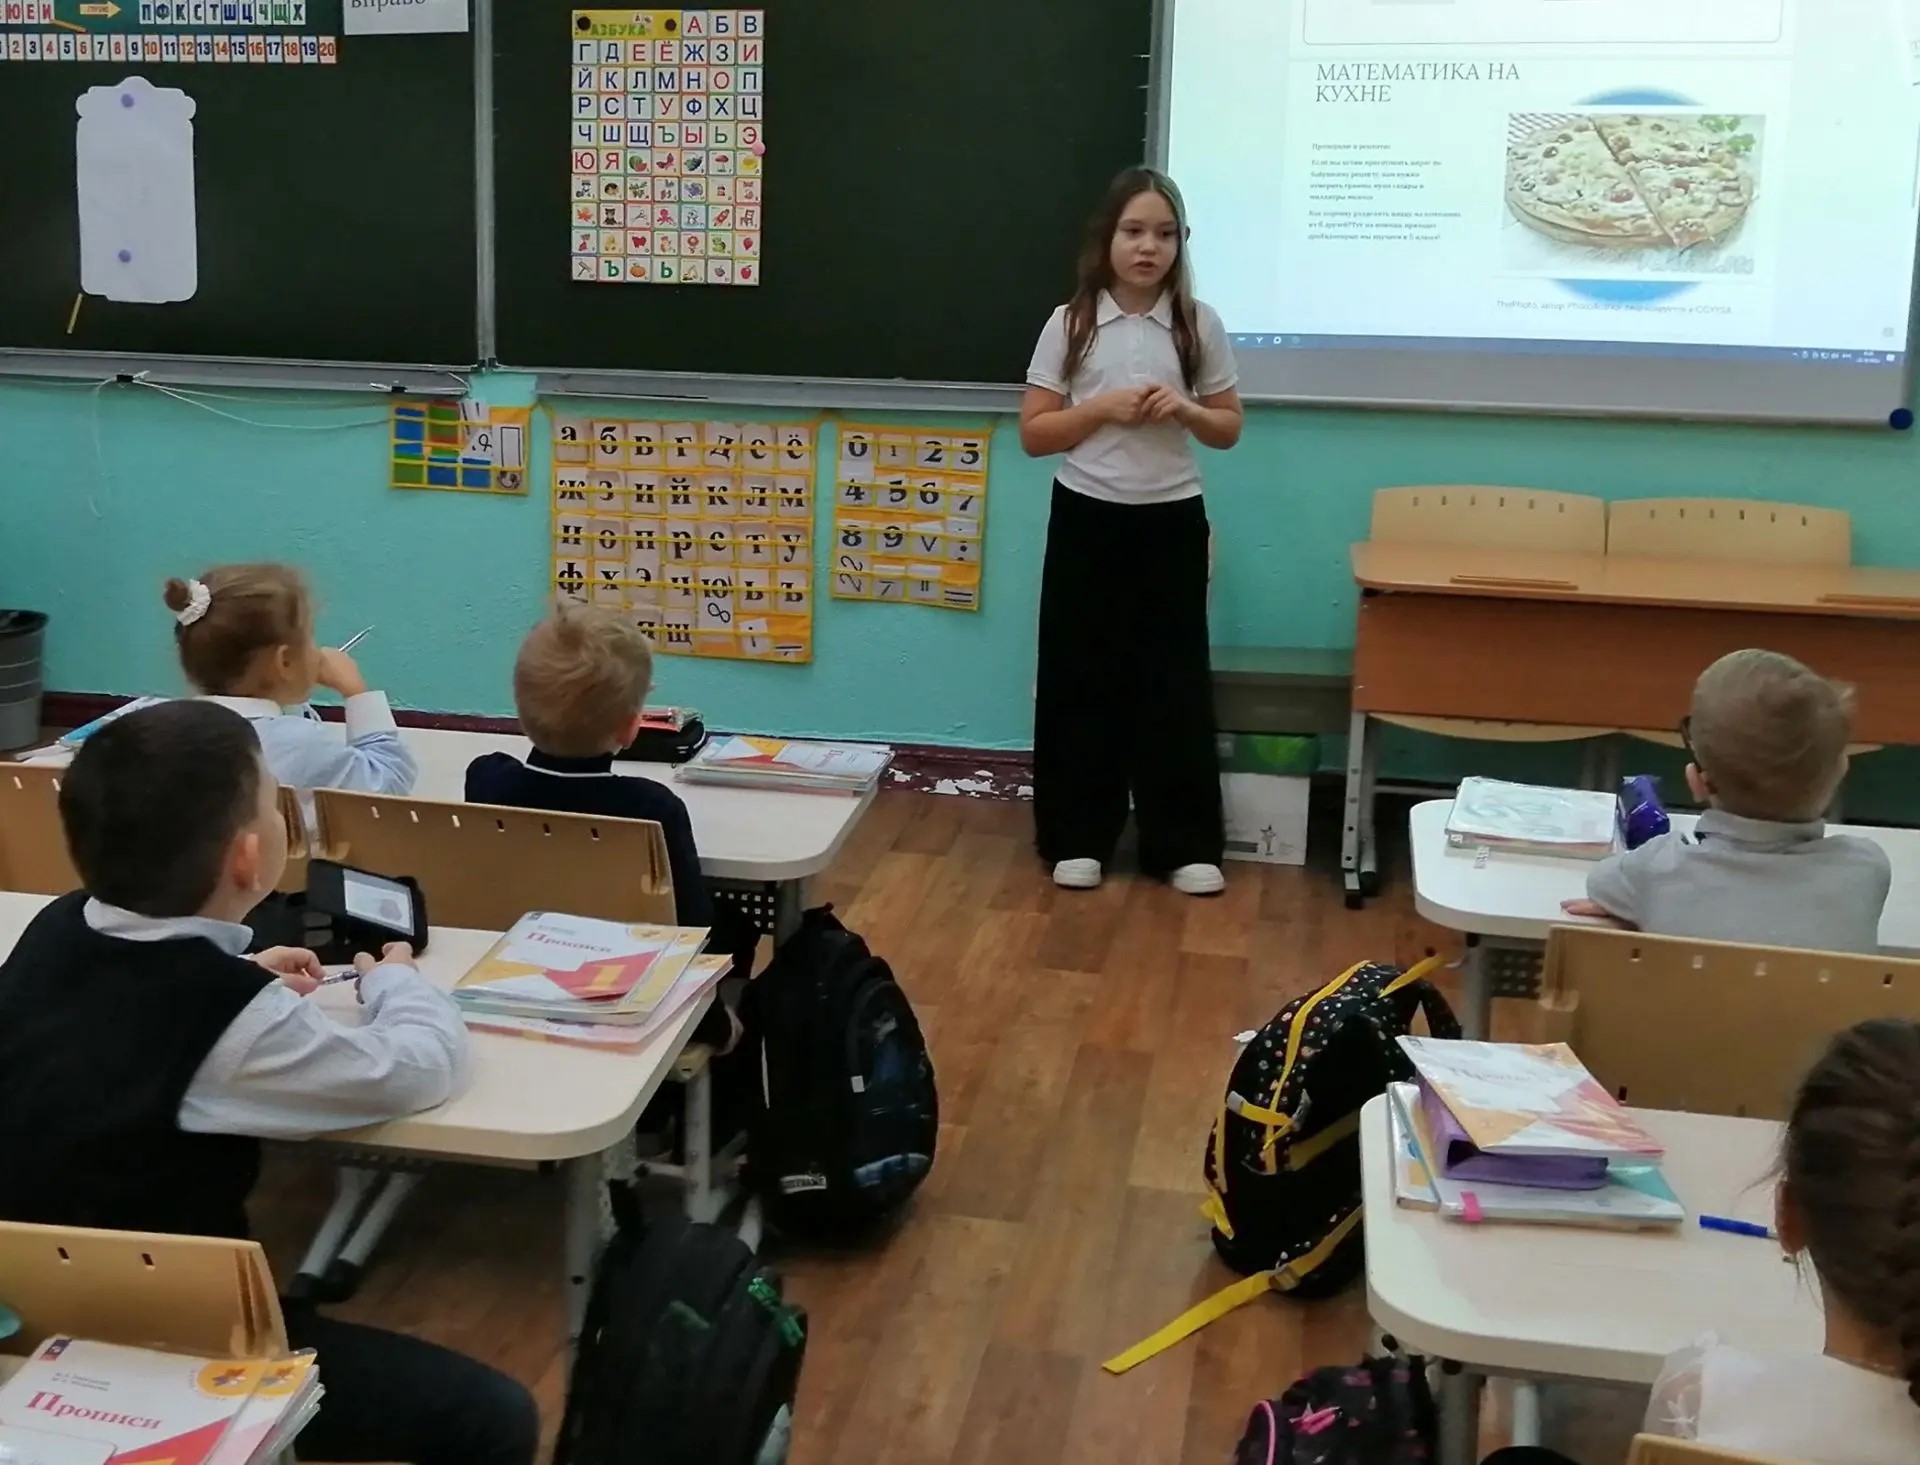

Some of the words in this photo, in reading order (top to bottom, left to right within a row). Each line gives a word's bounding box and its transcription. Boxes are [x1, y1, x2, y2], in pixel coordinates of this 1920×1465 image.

[591, 24, 645, 36] АЗБУКА
[688, 16, 701, 33] А
[716, 16, 728, 32] Б
[745, 16, 757, 32] В
[580, 44, 590, 60] Г
[606, 44, 619, 62] Д
[634, 45, 645, 61] Е
[661, 41, 672, 61] Ё
[685, 44, 703, 61] Ж
[716, 44, 728, 61] З
[744, 45, 757, 61] И
[579, 68, 591, 88] Й
[606, 72, 617, 89] К
[633, 72, 645, 89] Л
[659, 73, 674, 89] М
[688, 73, 700, 89] Н
[714, 72, 729, 89] О
[744, 73, 756, 89] П
[1317, 63, 1480, 80] МАТЕМАТИКА
[1488, 63, 1520, 80] НА
[1316, 85, 1392, 102] КУХНЕ
[579, 97, 591, 113] Р
[605, 97, 618, 115] С
[633, 98, 645, 114] Т
[660, 98, 673, 115] У
[687, 98, 701, 115] Ф
[716, 98, 728, 115] Х
[743, 98, 757, 118] Ц
[579, 125, 591, 142] Ч
[604, 126, 620, 142] Ш
[630, 126, 648, 145] Щ
[658, 126, 674, 142] Ъ
[686, 127, 702, 143] Ы
[715, 127, 727, 143] Ь
[743, 127, 757, 144] Э
[576, 152, 595, 169] Ю
[605, 153, 619, 169] Я
[561, 426, 577, 442] а
[600, 426, 617, 454] б
[634, 435, 653, 456] в
[675, 436, 692, 457] г
[710, 435, 734, 462] д
[848, 435, 868, 457] 0
[924, 441, 943, 463] 2
[559, 479, 586, 500] ж
[599, 480, 613, 501] з
[635, 483, 654, 504] и
[670, 477, 691, 505] й
[707, 486, 728, 506] к
[746, 487, 768, 506] л
[780, 487, 805, 507] м
[845, 478, 865, 501] 4
[889, 480, 907, 502] 5
[919, 482, 939, 505] 6
[959, 489, 974, 511] 7
[562, 525, 583, 545] н
[599, 529, 617, 549] о
[635, 530, 654, 549] п
[672, 531, 692, 559] р
[746, 534, 765, 553] т
[782, 534, 801, 562] у
[842, 525, 862, 547] 8
[883, 526, 903, 548] 9
[25, 1391, 162, 1429] Прописи
